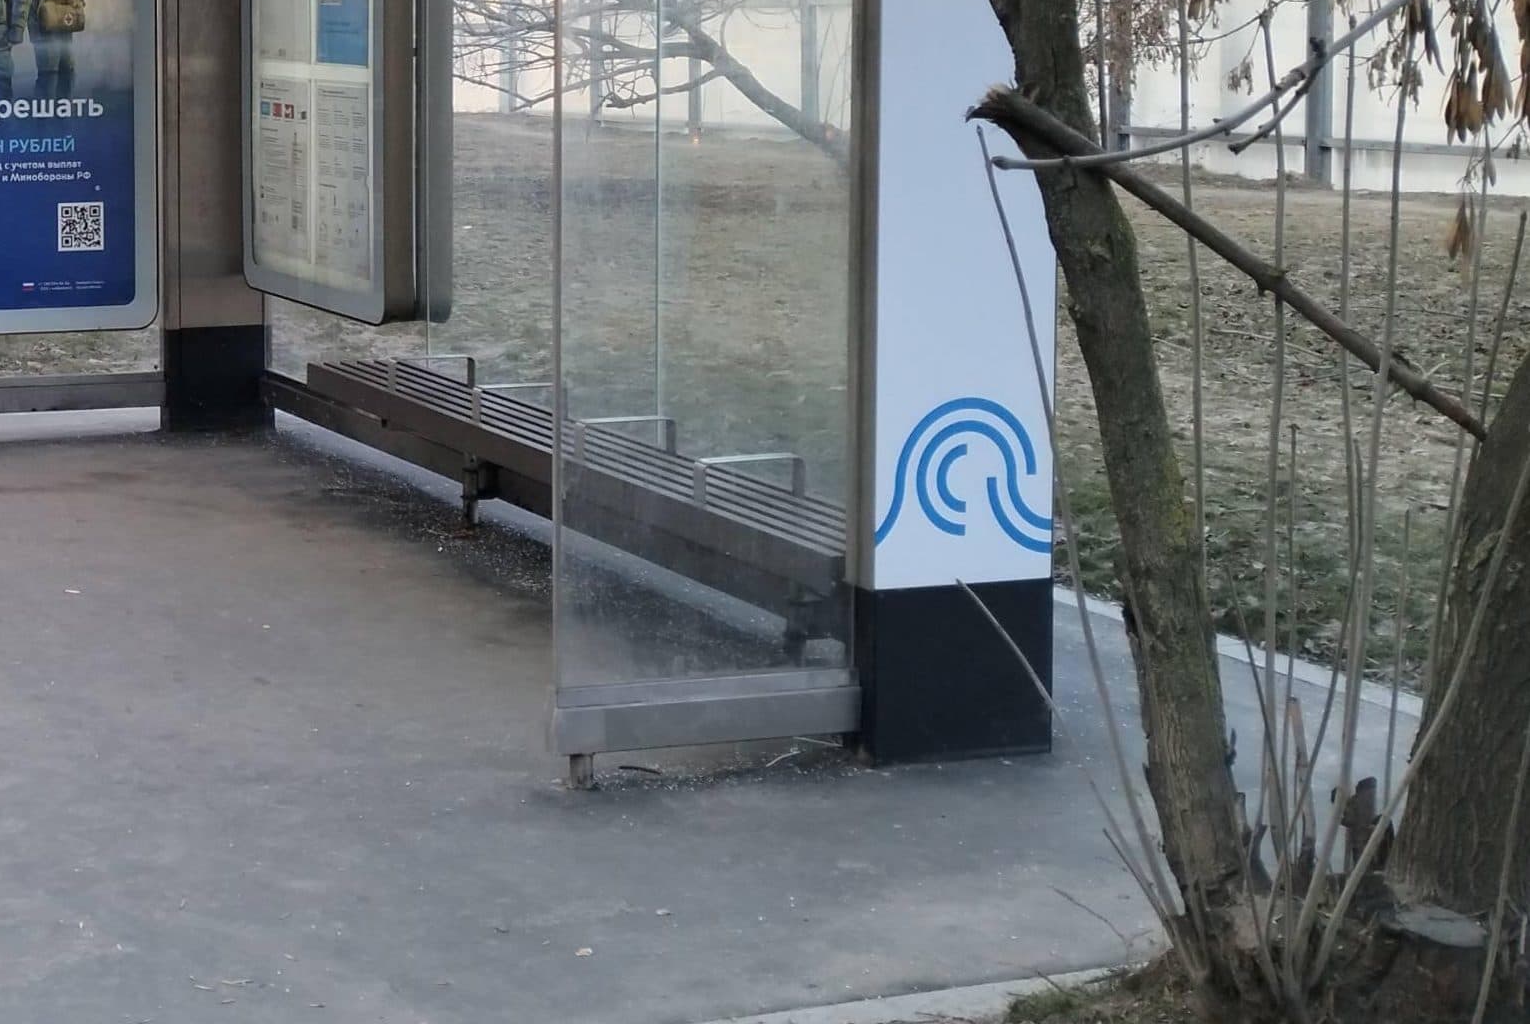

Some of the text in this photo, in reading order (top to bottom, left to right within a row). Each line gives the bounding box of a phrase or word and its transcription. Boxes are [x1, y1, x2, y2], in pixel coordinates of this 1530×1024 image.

[8, 135, 76, 154] РУБЛЕЙ
[47, 161, 82, 169] выплат
[10, 171, 75, 182] Минобороны
[76, 171, 92, 180] РФ
